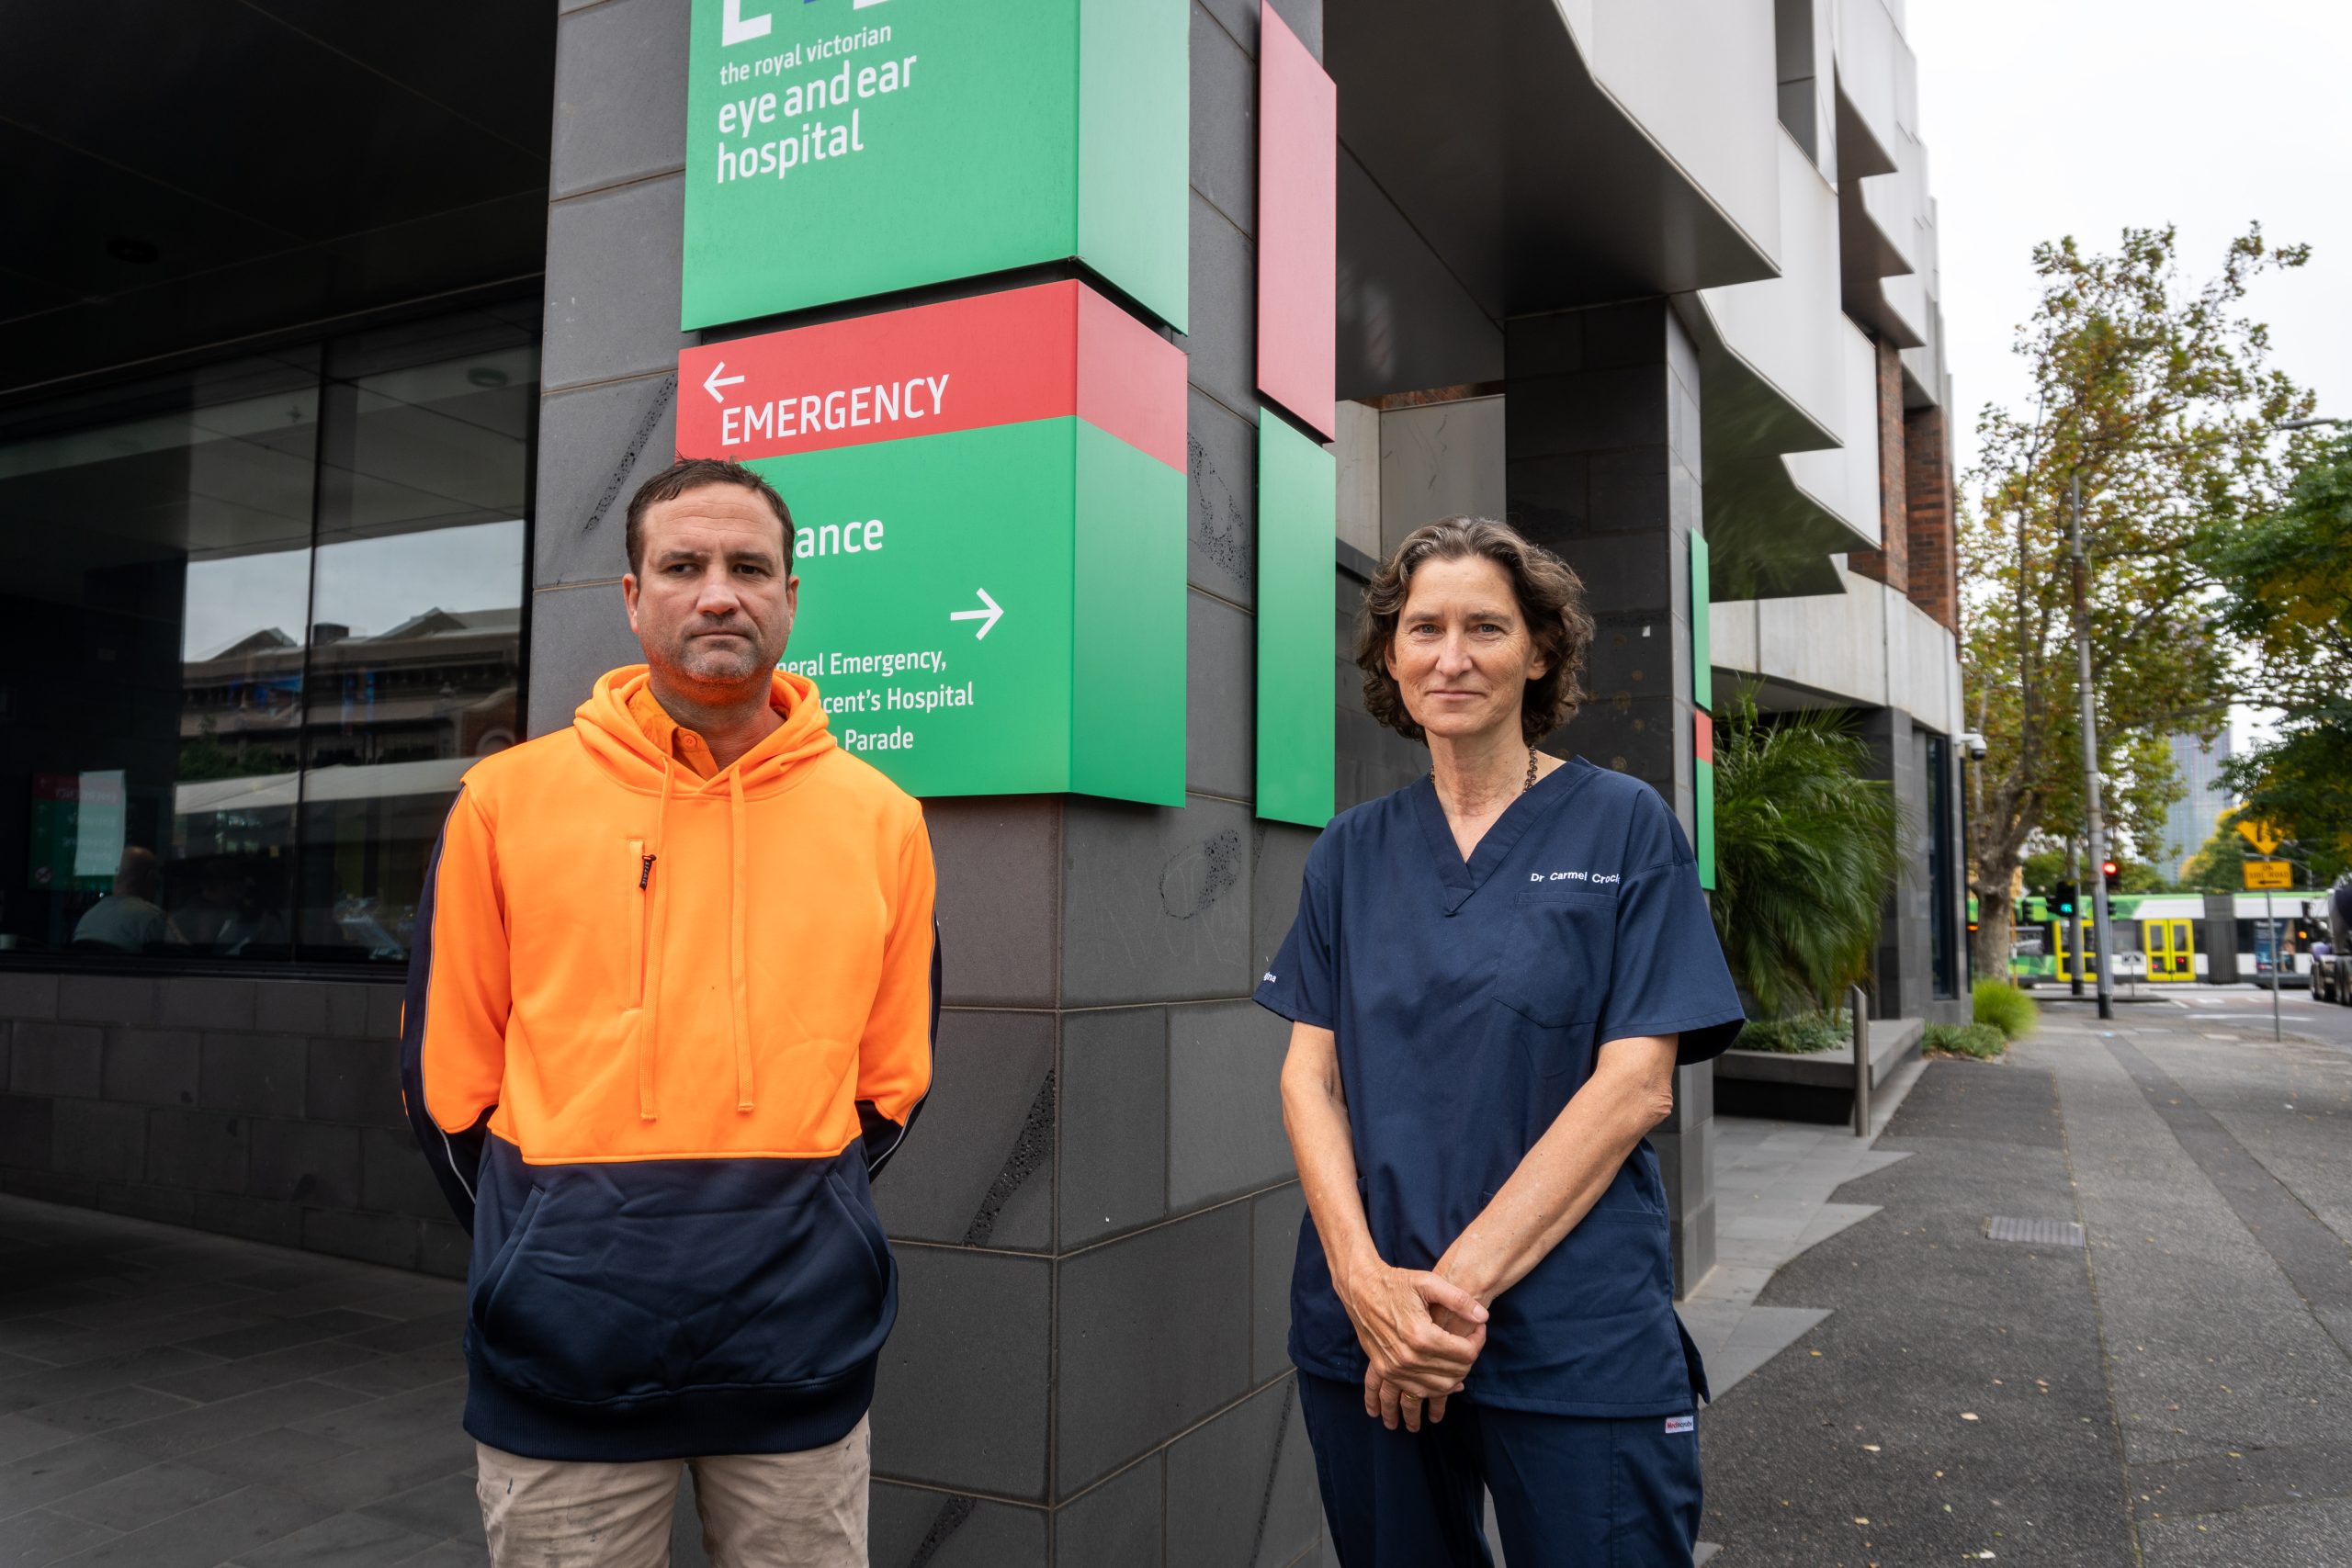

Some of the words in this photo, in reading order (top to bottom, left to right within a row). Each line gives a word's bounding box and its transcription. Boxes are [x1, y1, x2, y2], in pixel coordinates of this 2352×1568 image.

[720, 62, 750, 85] the
[754, 43, 802, 76] royal
[807, 26, 891, 62] victorian
[718, 93, 777, 138] eye
[783, 60, 851, 118] and
[856, 54, 917, 99] ear
[718, 108, 864, 184] hospital
[721, 374, 949, 446] EMERGENCY
[796, 519, 884, 558] ance
[775, 652, 824, 677] neral
[831, 650, 946, 677] Emergency,
[823, 690, 880, 714] cent's
[888, 682, 974, 712] Hospital
[845, 726, 914, 751] Parade
[1531, 873, 1544, 883] Dr
[1550, 871, 1588, 882] Carmel
